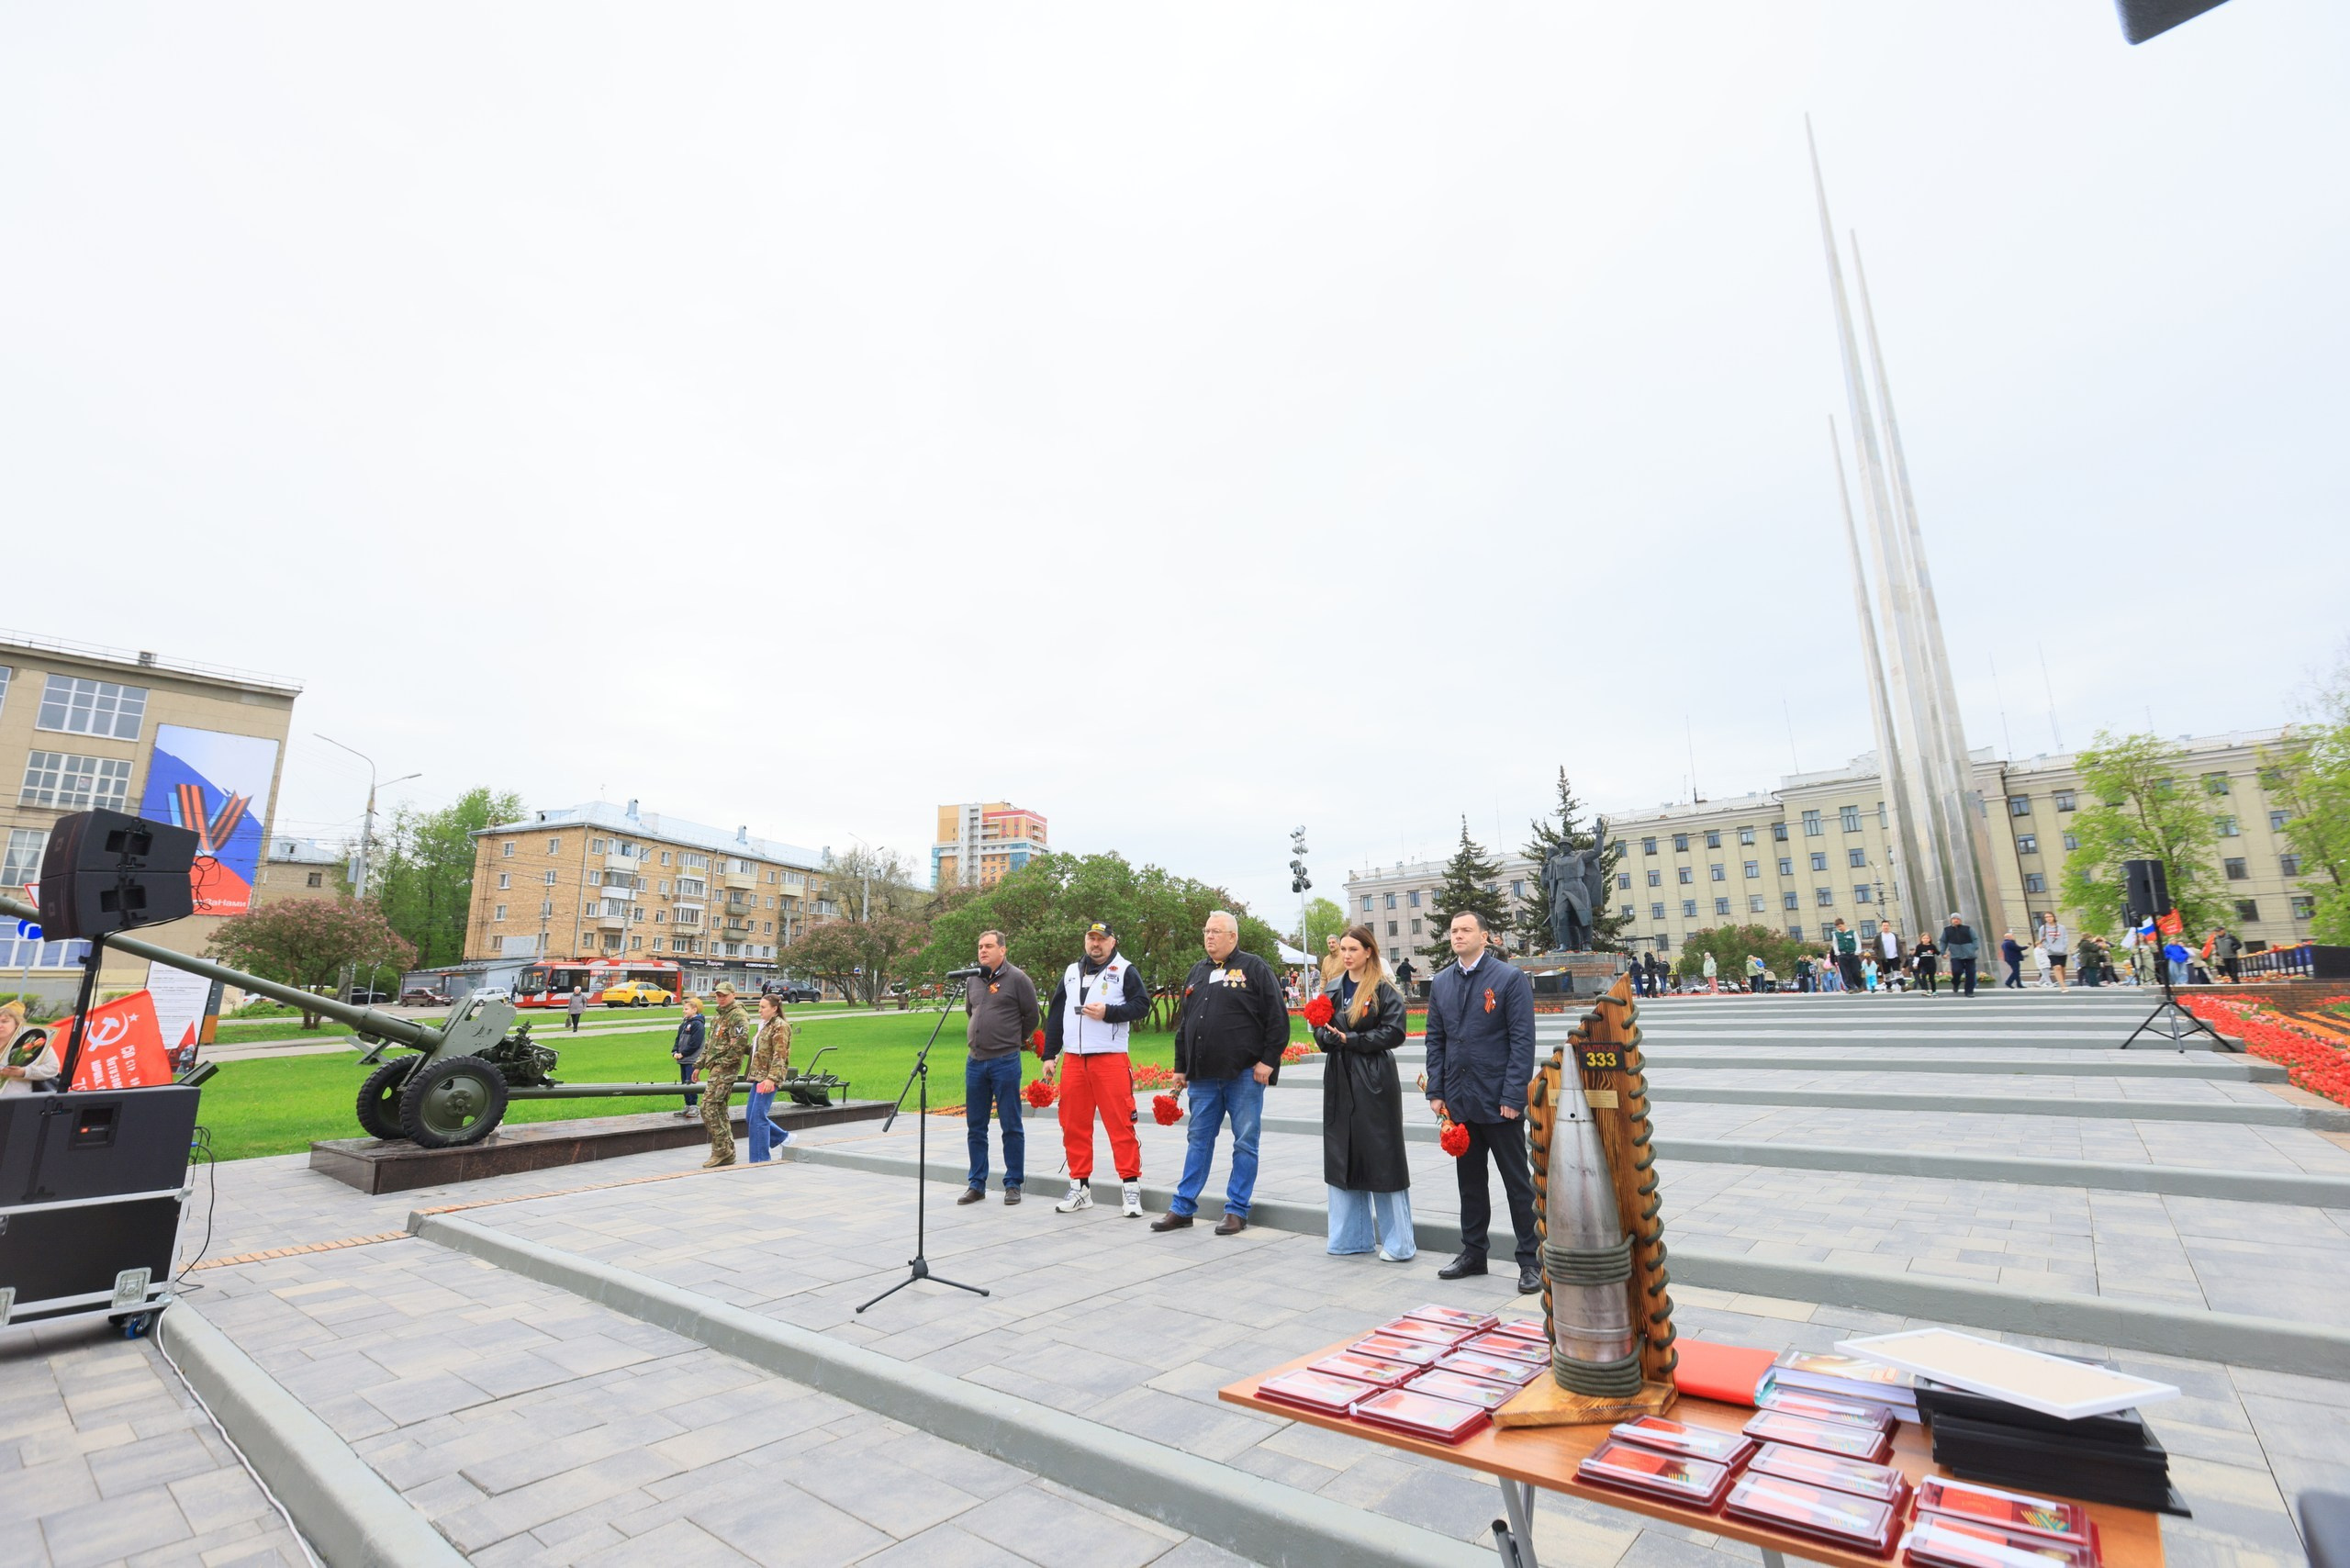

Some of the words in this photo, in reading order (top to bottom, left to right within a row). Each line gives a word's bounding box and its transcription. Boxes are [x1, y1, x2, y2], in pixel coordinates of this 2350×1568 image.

[193, 898, 247, 907] ЗаНами
[120, 1045, 136, 1059] 150
[1586, 1052, 1617, 1068] 333
